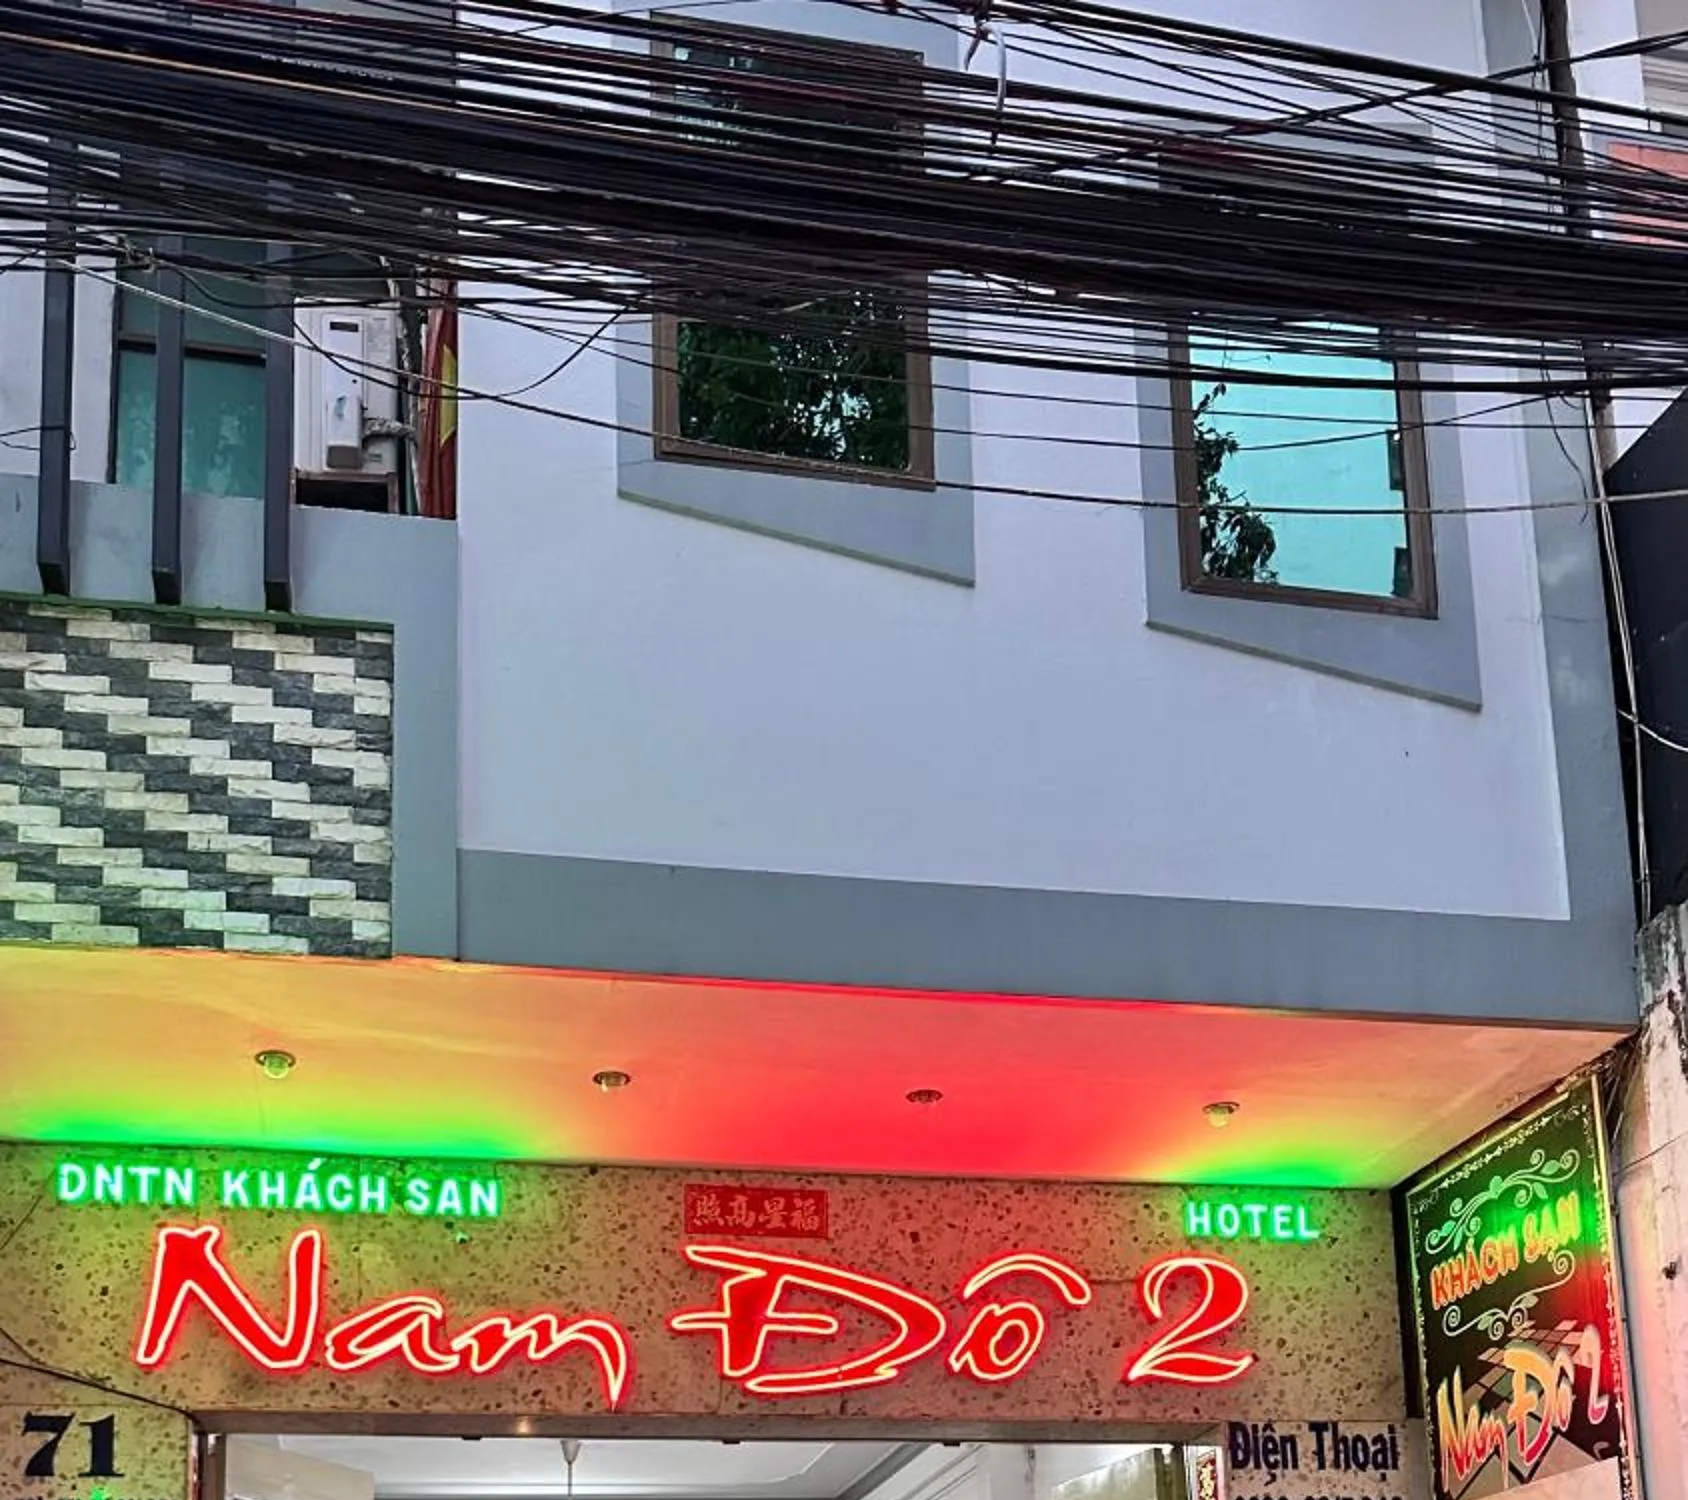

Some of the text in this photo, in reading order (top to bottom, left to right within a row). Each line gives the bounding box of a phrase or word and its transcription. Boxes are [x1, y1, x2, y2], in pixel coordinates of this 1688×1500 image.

[59, 1162, 194, 1203] DNTN
[223, 1157, 388, 1213] KHÁCH
[1187, 1200, 1320, 1239] HOTEL
[1429, 1190, 1583, 1311] KHÁCH SẠN
[136, 1225, 1257, 1412] Nam Đô 2
[1437, 1322, 1610, 1494] Nam Đô 2
[21, 1411, 125, 1478] 71
[1228, 1418, 1400, 1487] Điện Thoại
